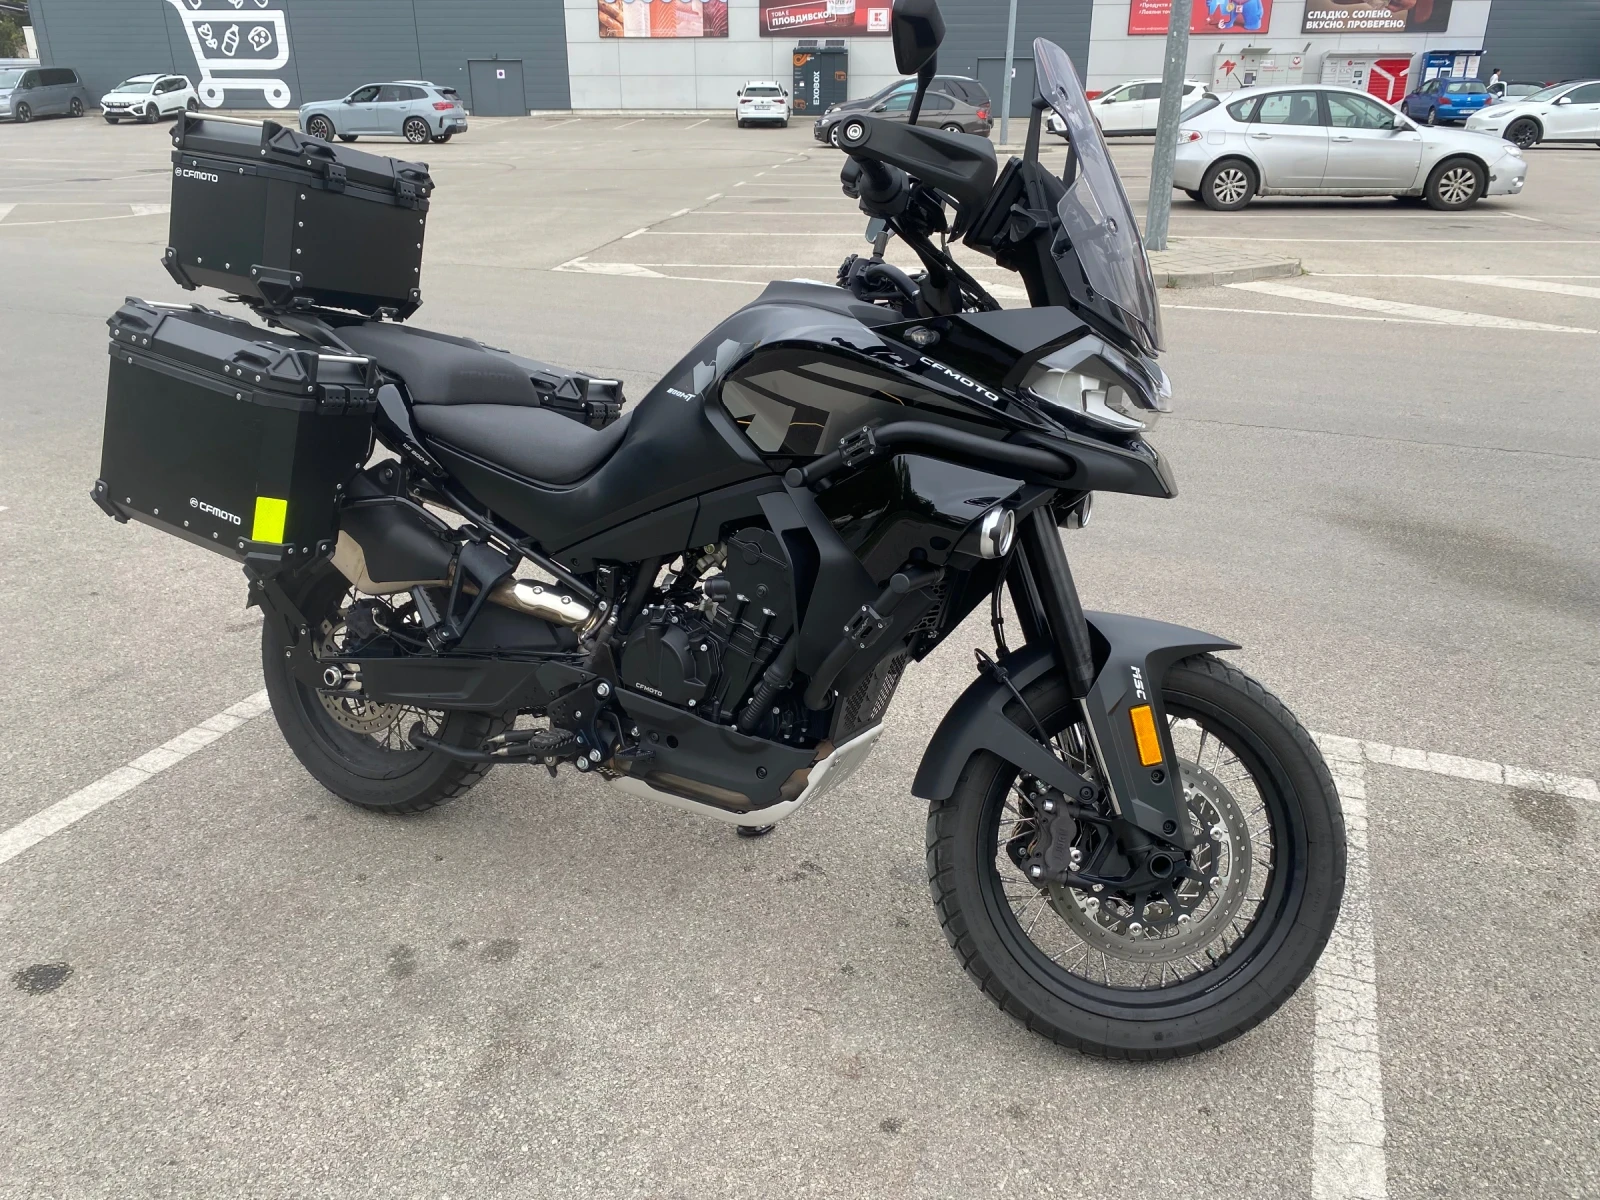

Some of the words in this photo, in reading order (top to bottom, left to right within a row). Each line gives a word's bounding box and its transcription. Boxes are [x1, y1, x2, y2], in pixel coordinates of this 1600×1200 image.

[772, 11, 832, 26] ПЛОВДИВСКО!
[1307, 11, 1350, 20] СЛАДКО.
[1352, 10, 1393, 18] СОЛЕНО.
[1306, 21, 1346, 29] ВКУСНО.
[1347, 20, 1406, 28] ПРОВЕРЕНО.
[812, 70, 820, 105] EXOBOX
[182, 169, 219, 183] CFMOTO
[919, 356, 999, 402] CFMOTO
[199, 501, 241, 526] CFMOTO
[635, 682, 663, 697] CFMOTO
[1130, 665, 1147, 701] MSC
